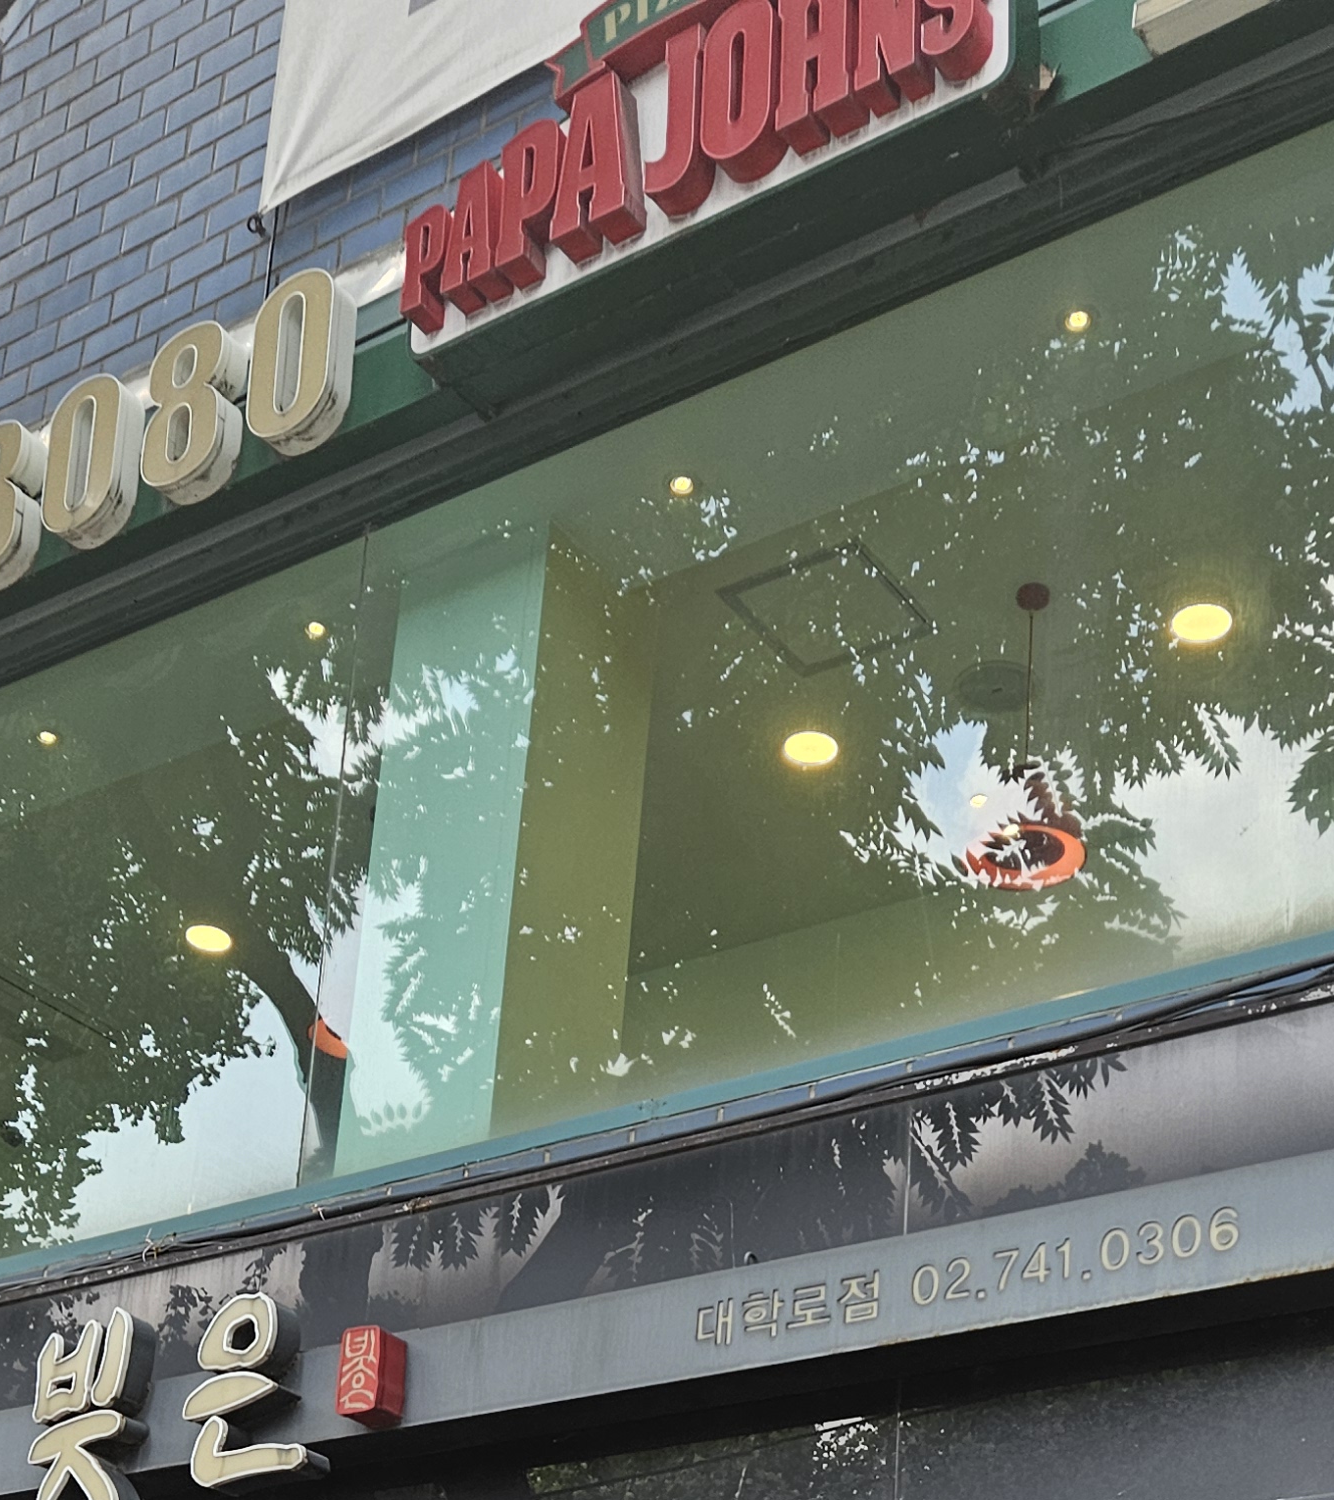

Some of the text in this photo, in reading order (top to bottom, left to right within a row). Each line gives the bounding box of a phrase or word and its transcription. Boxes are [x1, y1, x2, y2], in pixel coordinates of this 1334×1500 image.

[400, 70, 645, 334] PAPA
[695, 1207, 1240, 1347] 대학로점 02.741.0306
